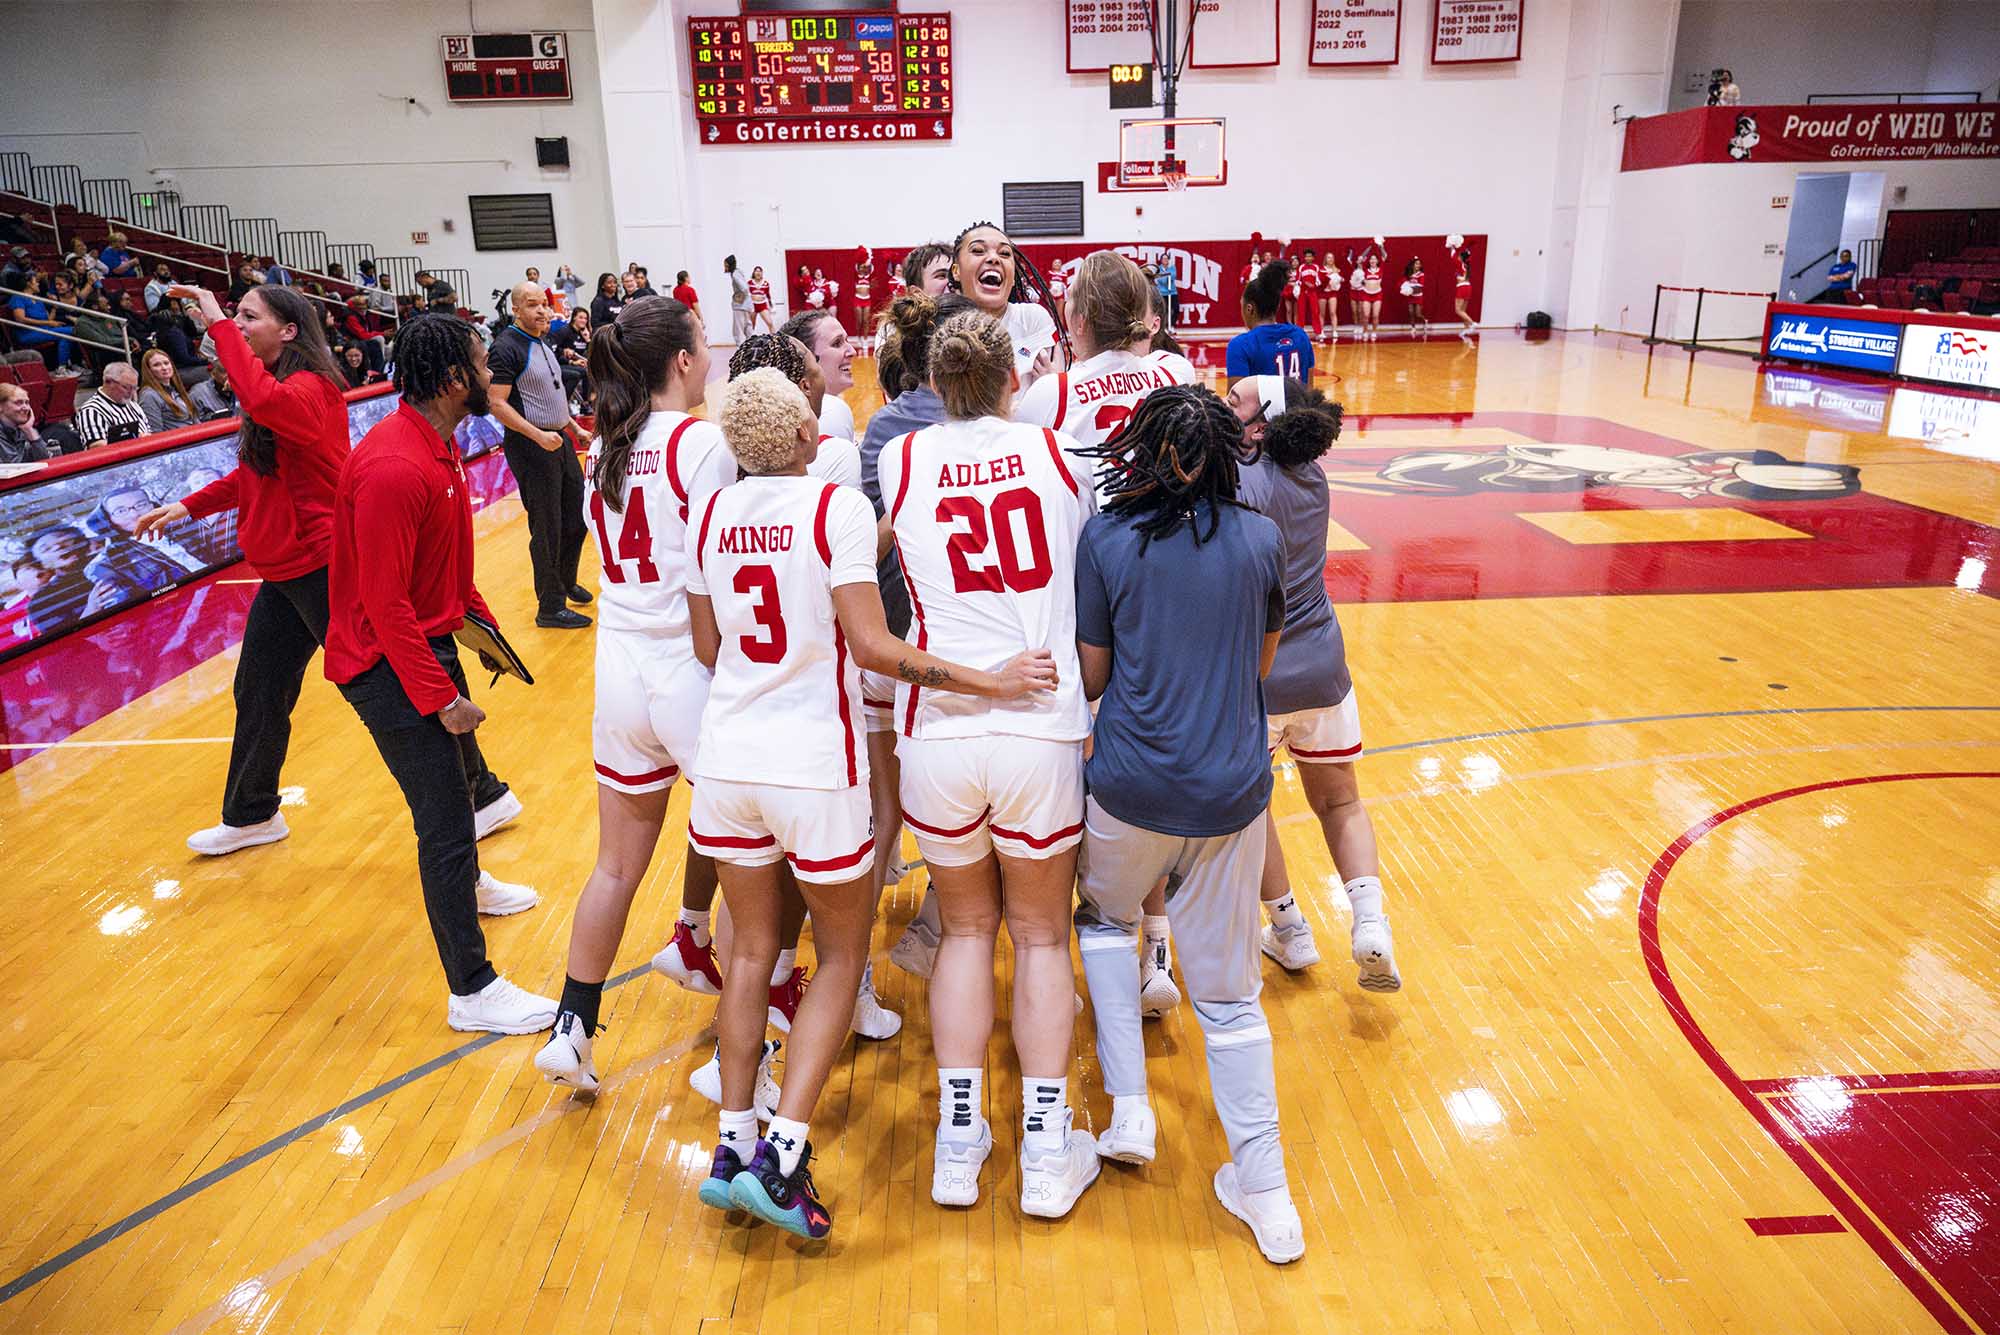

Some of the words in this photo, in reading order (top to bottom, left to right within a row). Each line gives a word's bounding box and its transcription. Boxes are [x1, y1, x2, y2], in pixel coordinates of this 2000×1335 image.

[1072, 4, 1096, 12] 1980
[1100, 3, 1123, 11] 1983
[1317, 10, 1341, 18] 2010
[1344, 9, 1395, 18] Semifinals
[1072, 15, 1095, 23] 1997
[1100, 14, 1123, 22] 1998
[1127, 13, 1149, 21] 200
[1441, 16, 1464, 25] 1983
[1467, 15, 1490, 23] 1988
[1494, 14, 1517, 22] 1990
[791, 18, 837, 40] 00.0
[869, 24, 893, 33] pepsi
[1072, 25, 1096, 33] 2003
[1100, 25, 1124, 33] 2004
[1317, 21, 1341, 29] 2022
[1440, 26, 1463, 35] 1997
[1466, 25, 1490, 34] 2002
[1493, 24, 1516, 33] 2011
[701, 32, 710, 45] 5
[713, 32, 721, 44] 2
[732, 32, 741, 44] 0
[905, 28, 918, 40] 11
[920, 27, 929, 40] 0
[932, 27, 948, 40] 20
[1346, 31, 1364, 39] CIT
[1316, 41, 1339, 49] 2013
[1342, 40, 1367, 49] 2016
[1438, 37, 1462, 46] 2020
[699, 49, 711, 62] 10
[714, 50, 723, 61] 4
[729, 49, 742, 61] 14
[905, 45, 918, 58] 12
[920, 45, 929, 58] 2
[936, 45, 949, 58] 10
[452, 62, 477, 72] HOME
[533, 60, 560, 70] GUEST
[757, 54, 783, 75] 60
[816, 54, 830, 74] 4
[867, 52, 892, 73] 58
[906, 63, 919, 75] 14
[921, 63, 930, 74] 4
[940, 62, 949, 74] 6
[719, 66, 725, 78] 1
[1111, 65, 1143, 82] 00.0
[824, 75, 854, 83] PLAYER
[907, 79, 919, 92] 15
[921, 79, 931, 92] 2
[941, 79, 950, 91] 9
[698, 84, 714, 96] 21
[717, 83, 725, 96] 2
[736, 83, 744, 95] 4
[759, 85, 772, 106] 5
[779, 85, 789, 99] 2
[881, 82, 894, 103] 5
[699, 101, 715, 113] 40
[719, 100, 727, 113] 3
[737, 100, 746, 112] 2
[811, 105, 849, 113] ADVANTAGE
[872, 104, 897, 112] SCORE
[903, 96, 919, 109] 24
[922, 96, 931, 109] 2
[941, 96, 950, 109] 5
[753, 106, 778, 114] SCORE
[736, 121, 917, 141] GoTerriers.com
[1782, 113, 1852, 139] Proud
[1856, 113, 1883, 141] of
[1889, 112, 1946, 140] WHO
[1955, 112, 1996, 139] WE
[1830, 142, 2000, 158] GoTerriers.com/WhoWeAre
[1122, 164, 1150, 176] Follow
[1829, 334, 1865, 348] STUDENT
[1864, 337, 1897, 353] VILLAGE
[1274, 348, 1301, 380] 14
[1074, 368, 1165, 405] SEMENOVA
[938, 453, 1026, 489] ADLER
[590, 486, 660, 584] 14
[717, 525, 793, 555] MINGO
[936, 486, 1053, 594] 20
[733, 564, 787, 665] 3
